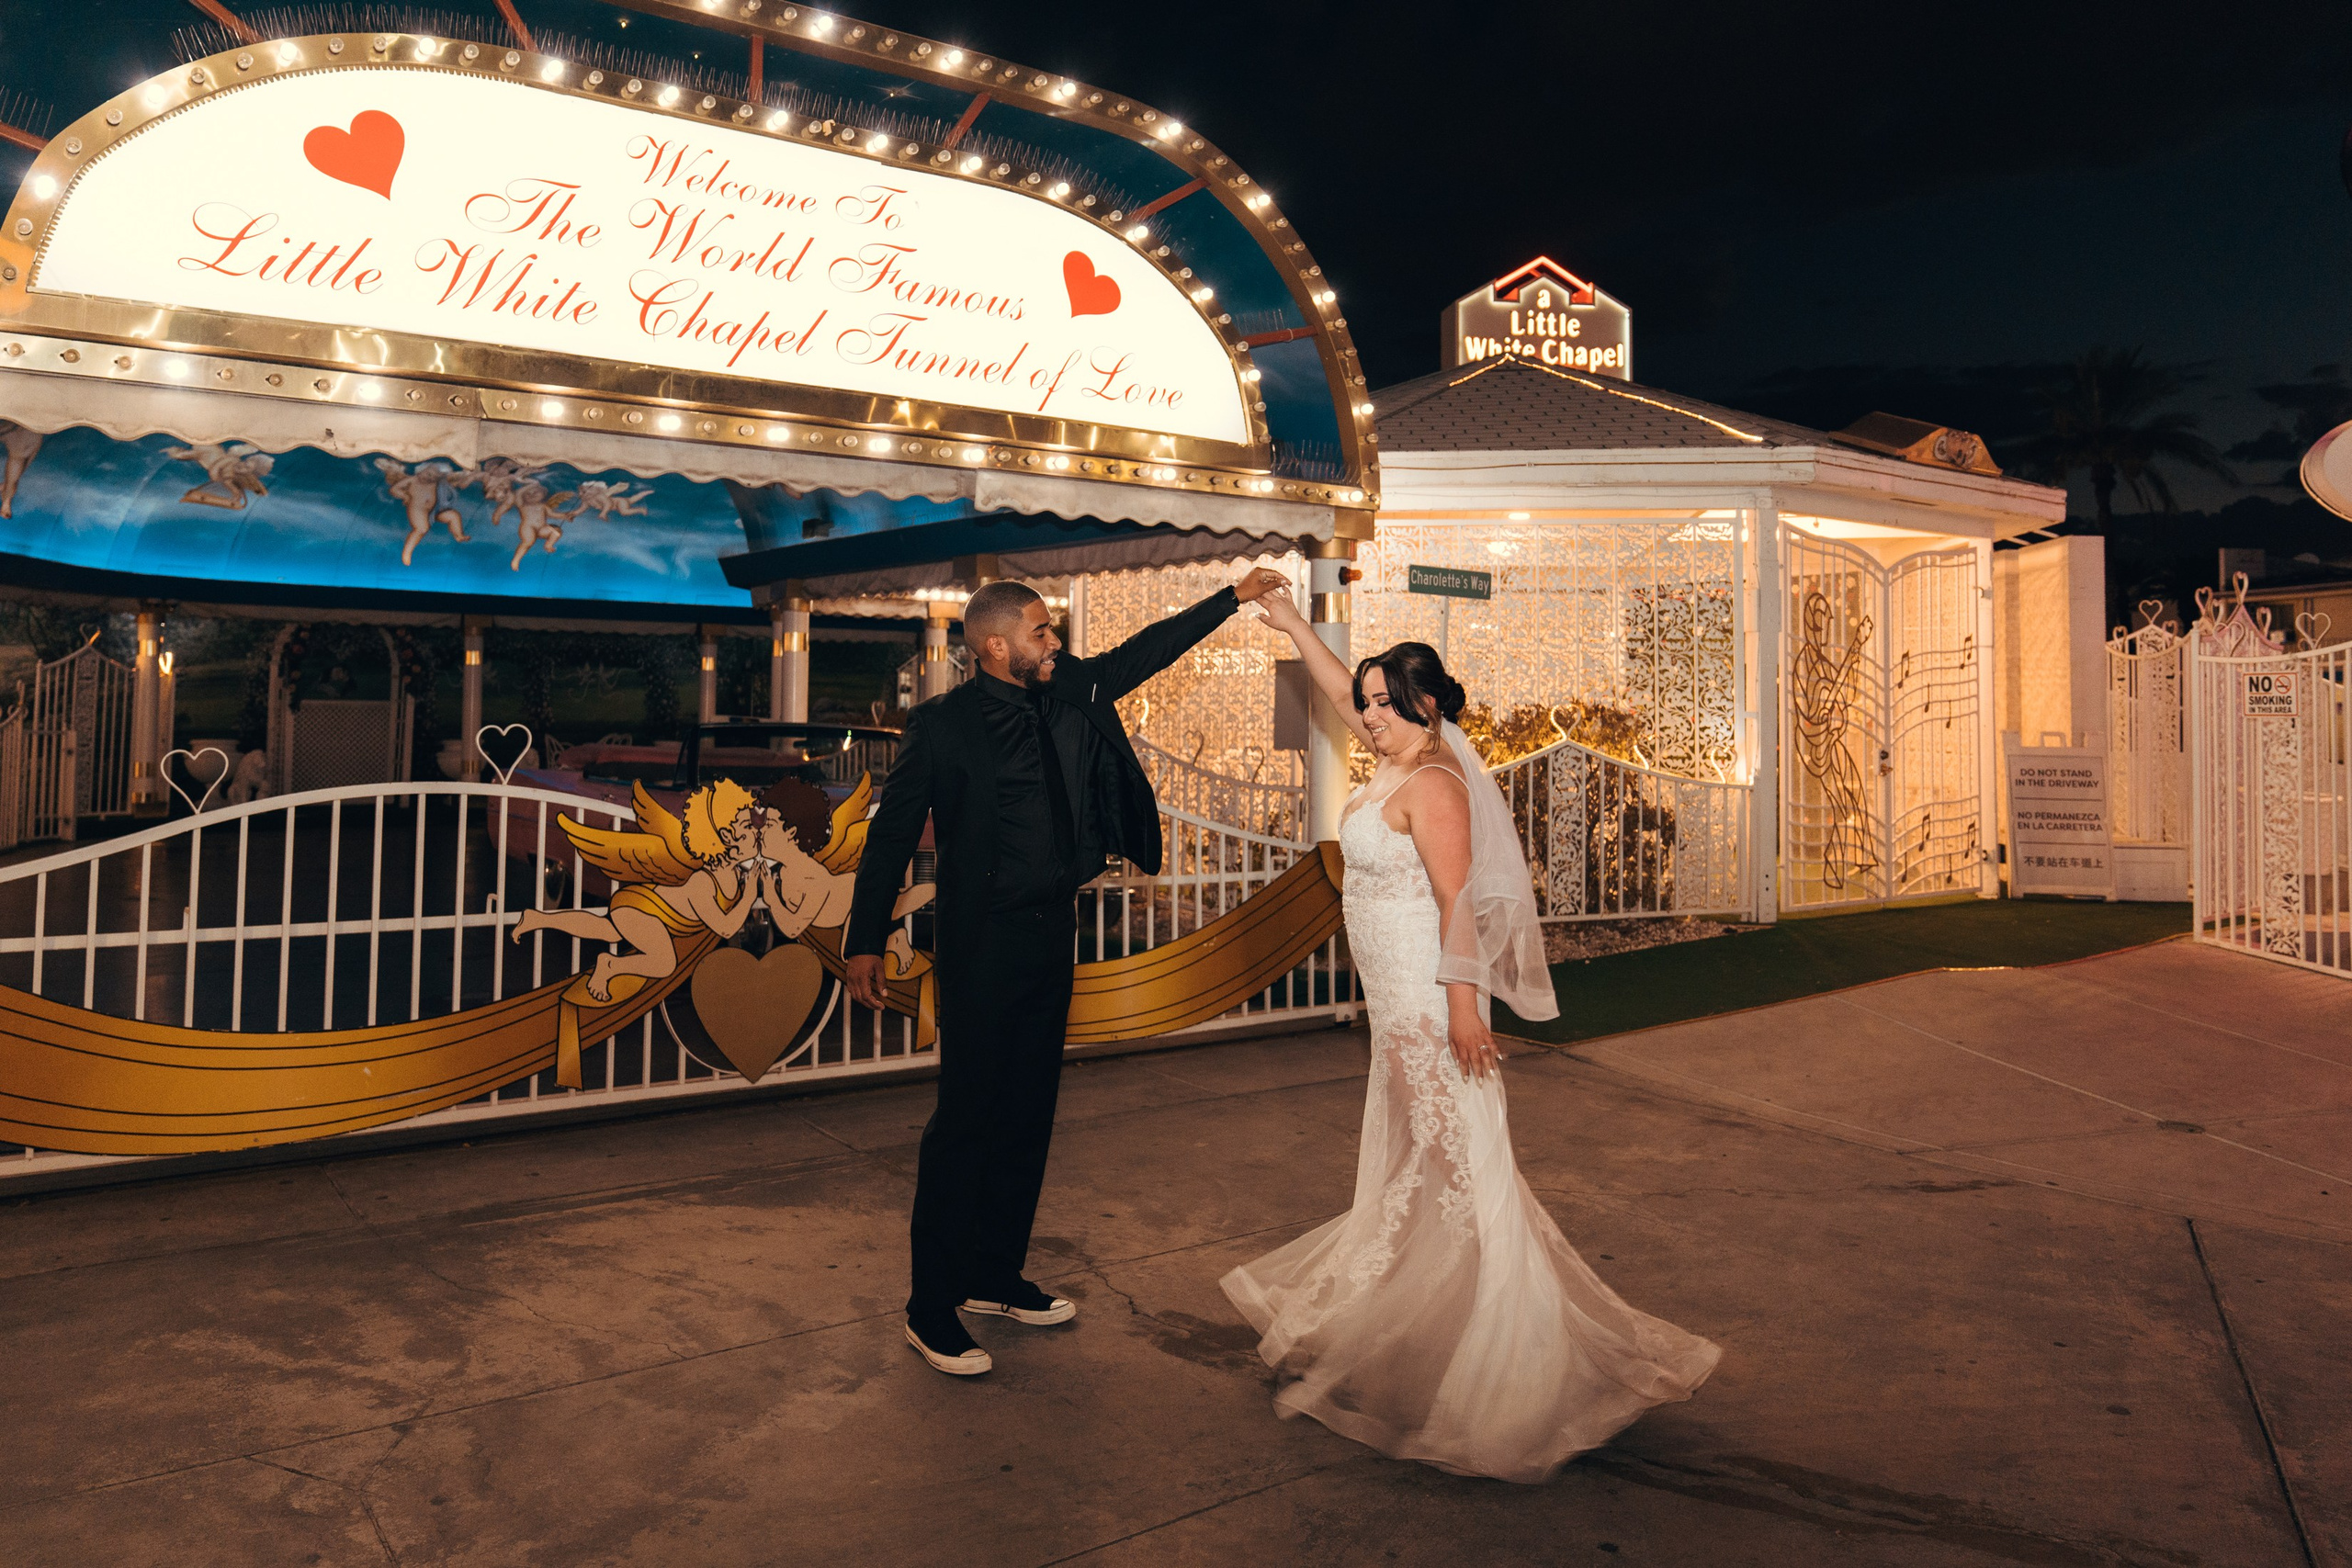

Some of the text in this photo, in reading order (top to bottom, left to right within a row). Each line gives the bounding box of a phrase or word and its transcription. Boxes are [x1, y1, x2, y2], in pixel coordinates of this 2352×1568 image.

[626, 135, 909, 231] Welcome To
[465, 177, 1026, 321] The World Famous
[177, 202, 1185, 412] Little White Chapel Tunnel of Love
[1536, 288, 1551, 309] a
[1510, 310, 1580, 337] Little
[1464, 335, 1624, 373] White Chapel
[1410, 570, 1490, 596] Charolette's Way
[2249, 676, 2272, 693] NO
[2248, 695, 2292, 705] SMOKING
[2020, 768, 2093, 778] DO NOT STAND
[2015, 778, 2100, 788] IN THE DRIVEWAY
[2017, 811, 2101, 821] NO PERMANEZCA
[2017, 822, 2030, 830] EN
[2046, 823, 2104, 832] CARRETERA
[2023, 855, 2105, 869] 不要站在车道上
